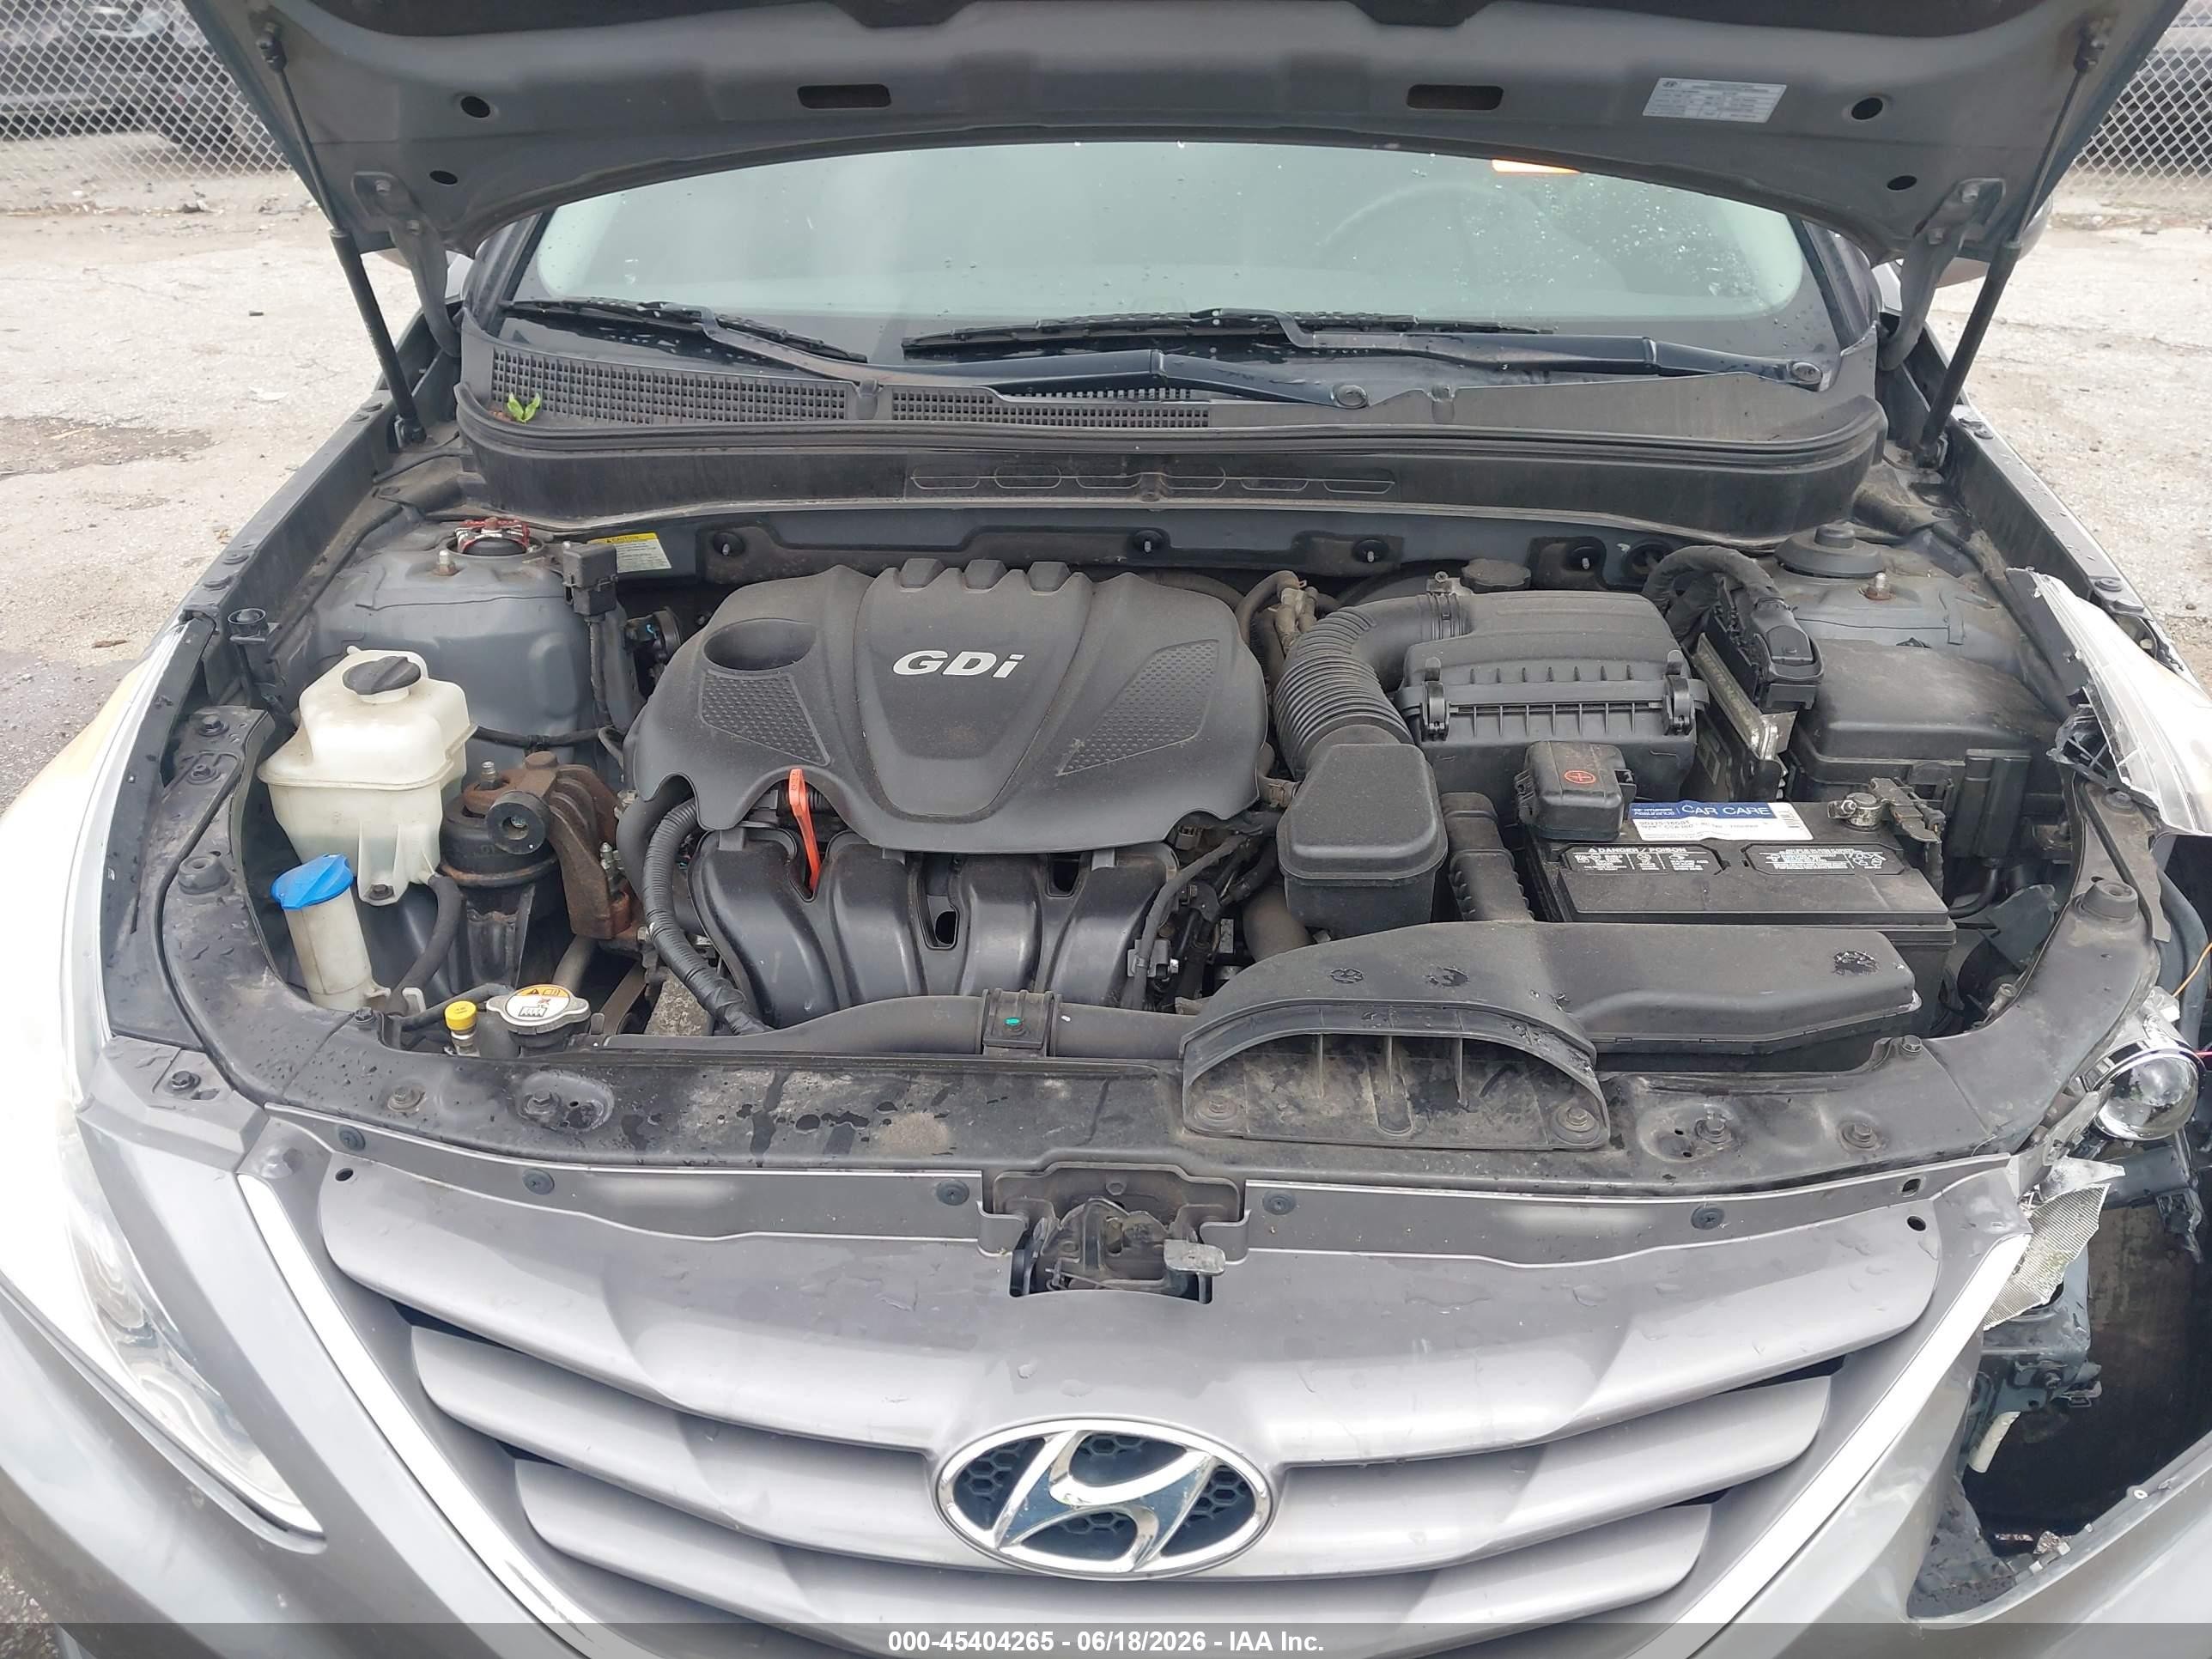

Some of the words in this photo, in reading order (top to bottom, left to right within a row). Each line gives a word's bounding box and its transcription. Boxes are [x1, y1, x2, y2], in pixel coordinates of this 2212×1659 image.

[893, 650, 1025, 678] GDi
[1681, 805, 1717, 815] CAR
[1723, 806, 1771, 815] CARE
